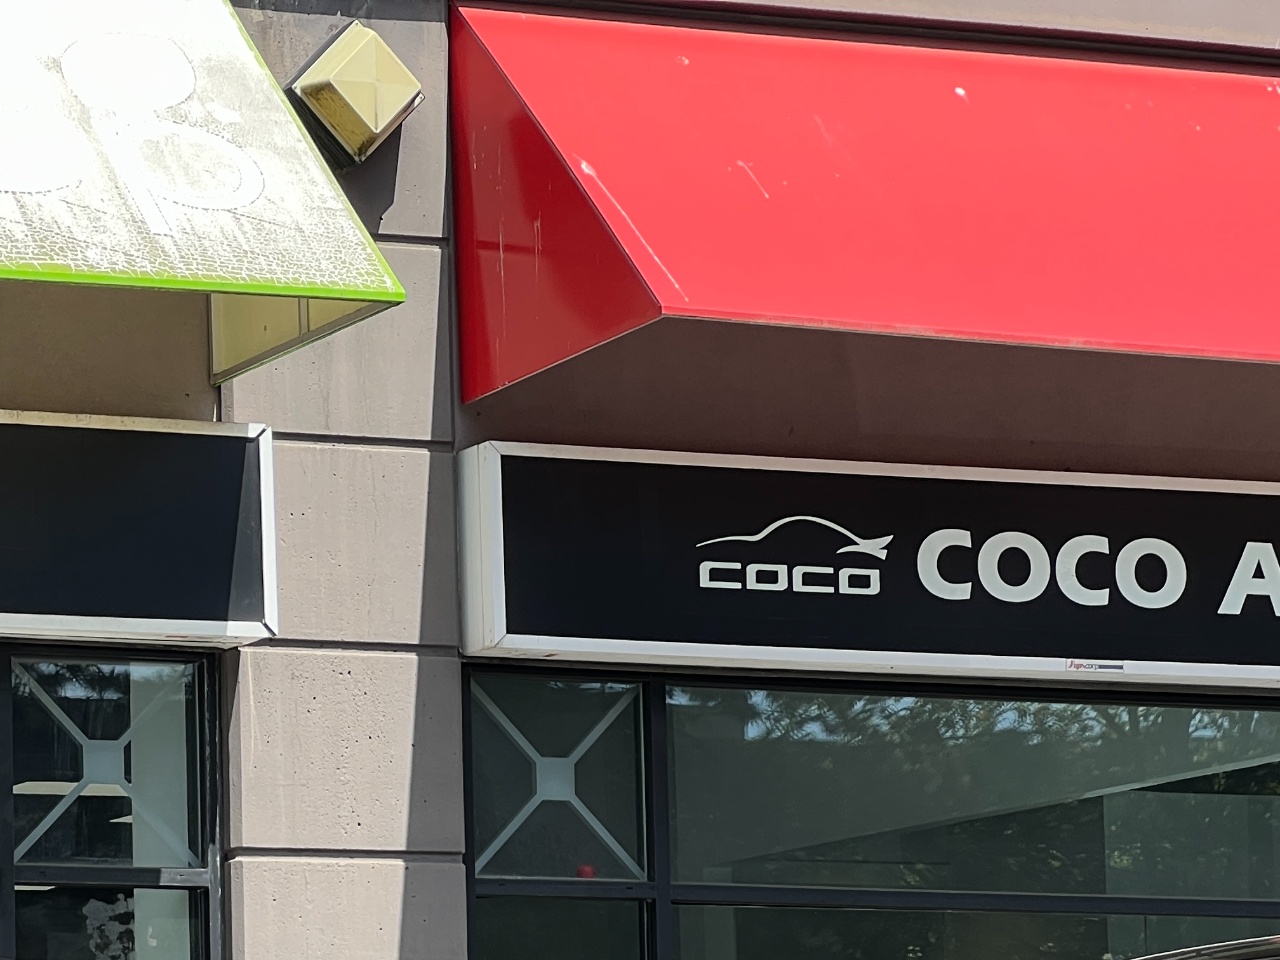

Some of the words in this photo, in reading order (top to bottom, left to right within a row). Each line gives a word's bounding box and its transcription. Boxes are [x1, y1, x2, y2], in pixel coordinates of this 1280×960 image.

[699, 560, 881, 596] COCO
[917, 528, 1187, 609] COCO
[1217, 541, 1280, 617] A
